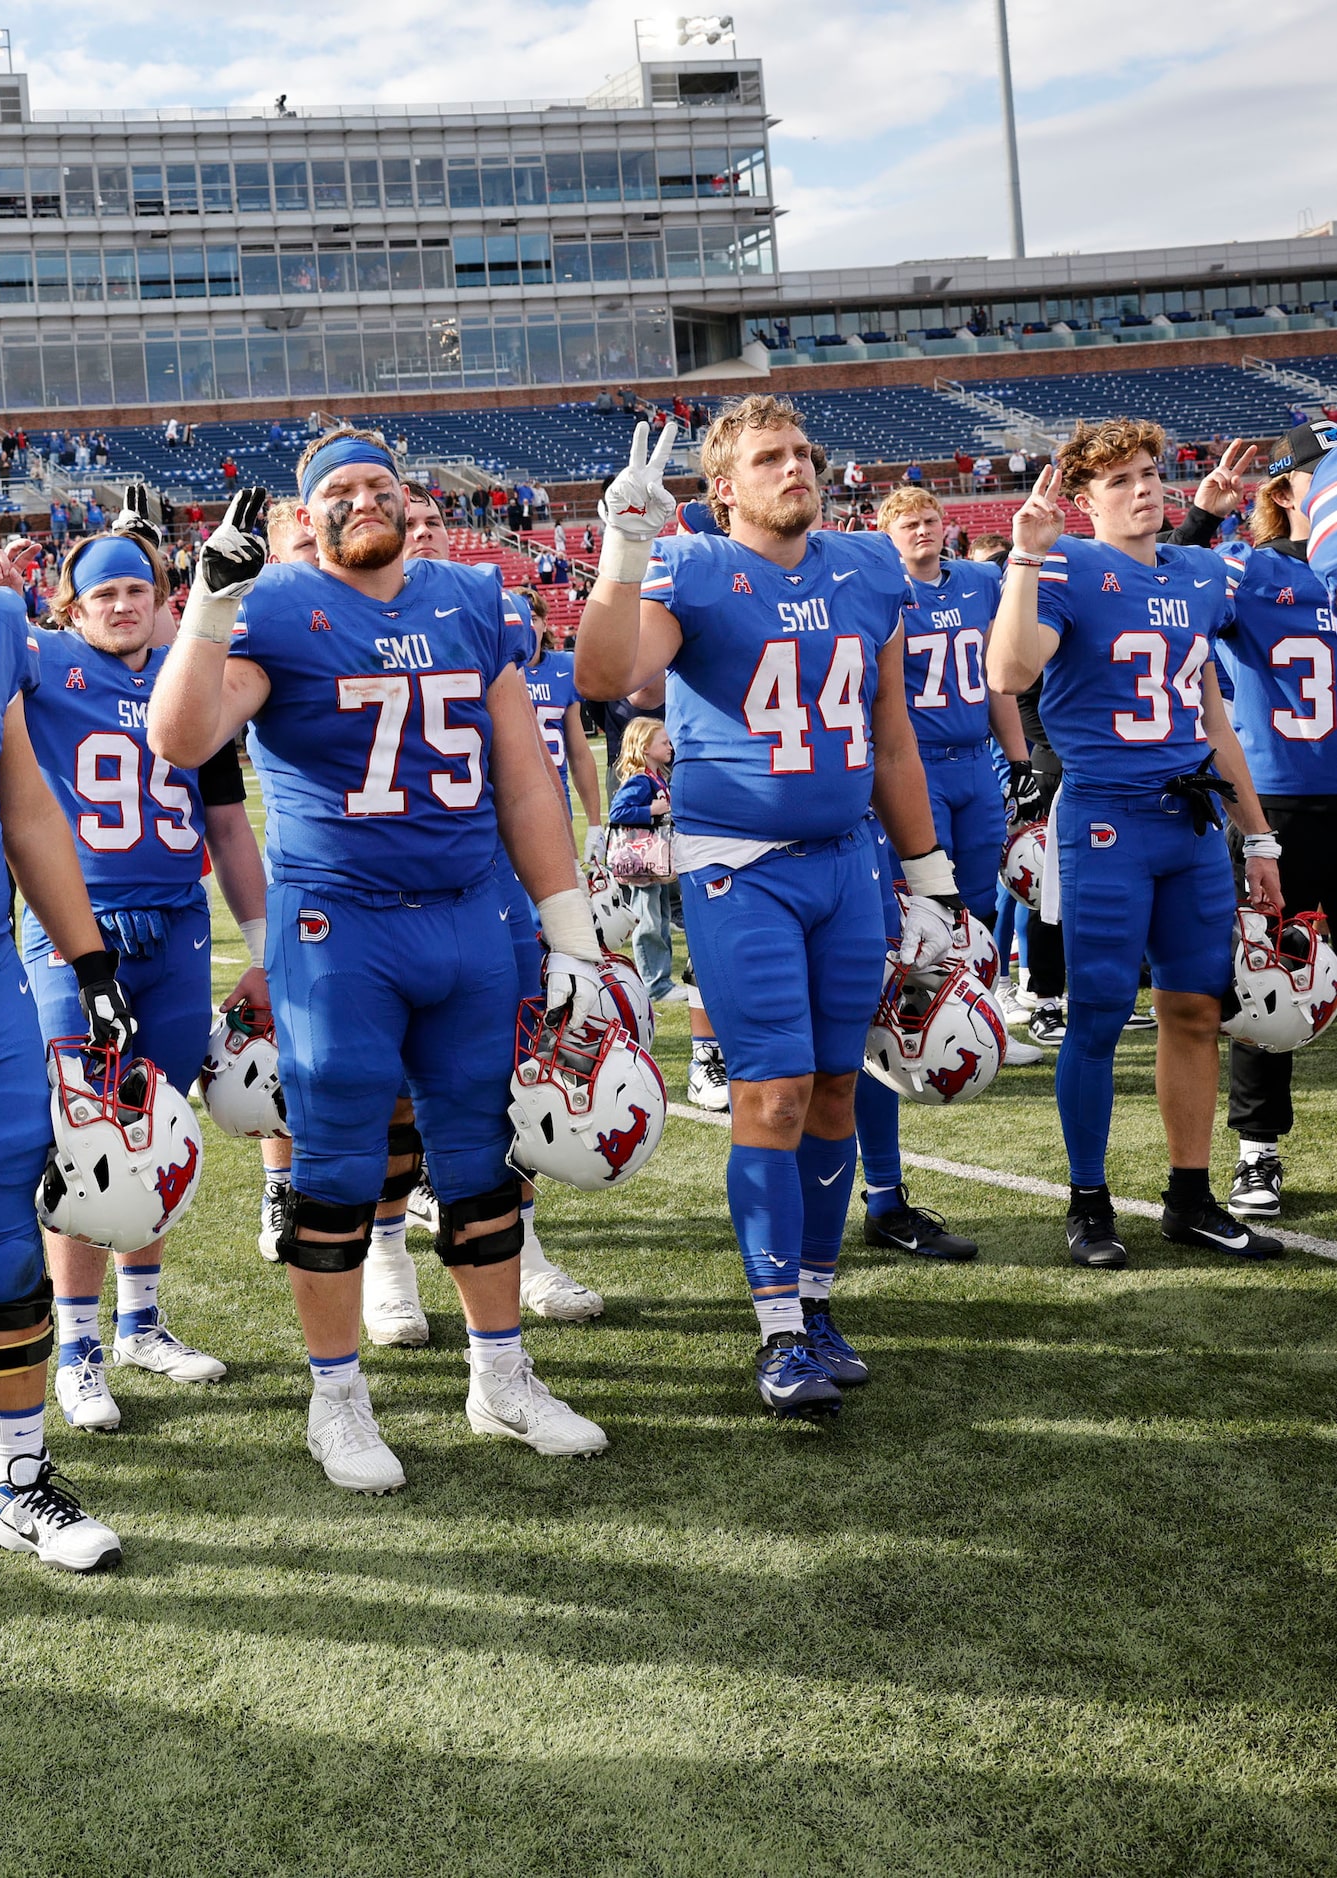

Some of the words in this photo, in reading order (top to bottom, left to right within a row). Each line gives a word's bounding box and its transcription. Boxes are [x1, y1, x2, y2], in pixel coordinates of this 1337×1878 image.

[1268, 455, 1293, 475] SMU
[778, 598, 830, 633] SMU
[930, 608, 962, 629] SMU
[1147, 598, 1190, 629] SMU
[375, 634, 434, 671] SMU
[906, 628, 986, 709] 70
[526, 683, 551, 700] SMU
[743, 634, 869, 775] 44
[1111, 630, 1210, 744] 34
[118, 699, 148, 728] SM
[336, 669, 486, 816] 75
[75, 732, 201, 854] 95
